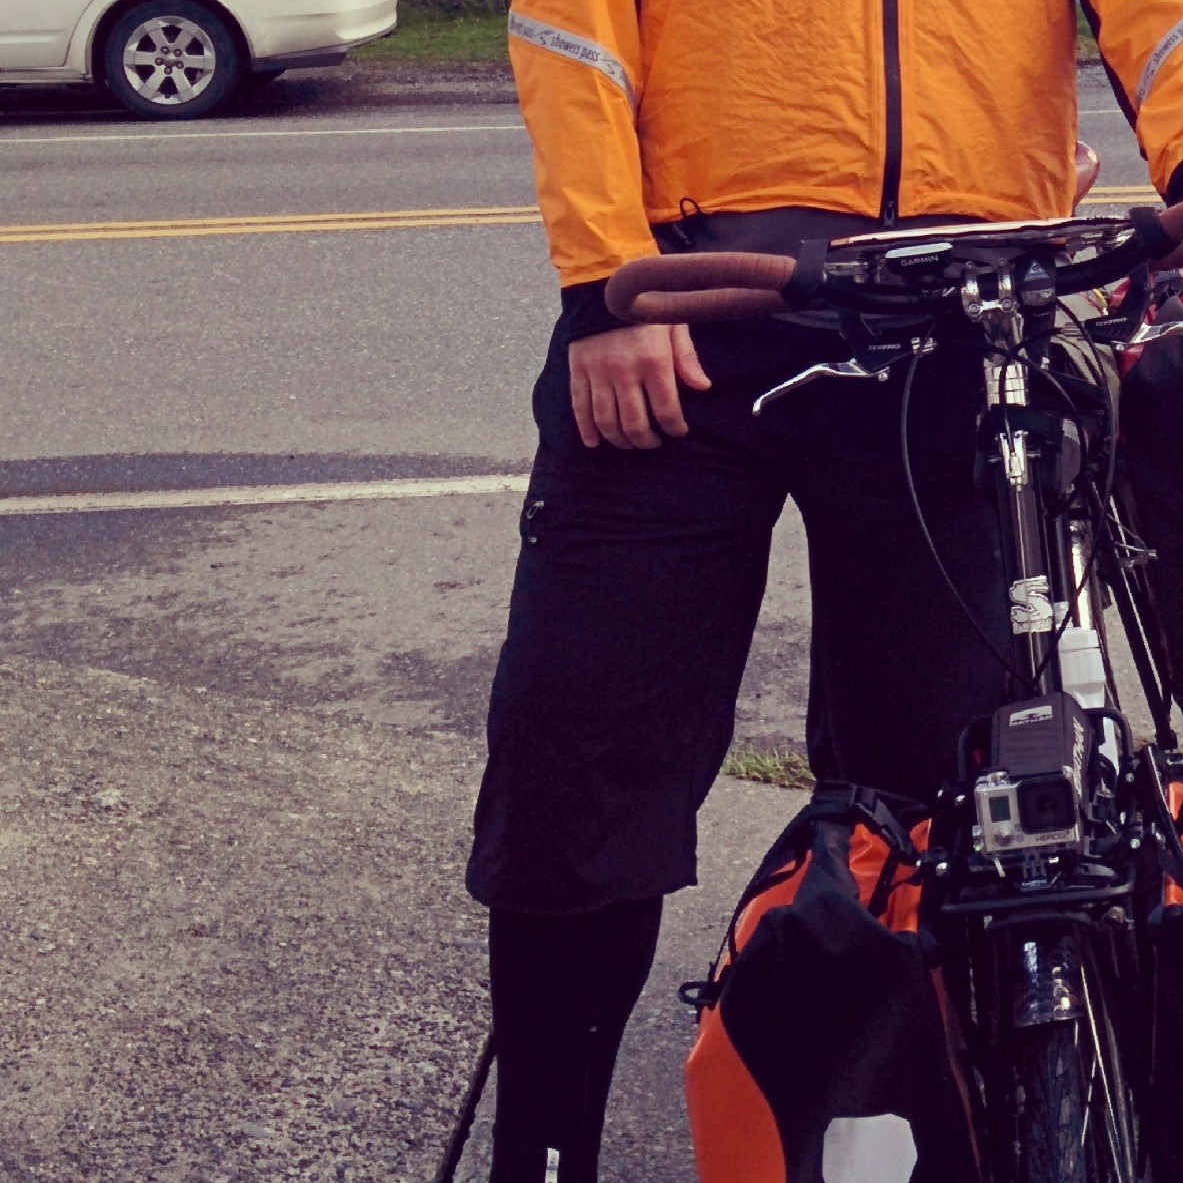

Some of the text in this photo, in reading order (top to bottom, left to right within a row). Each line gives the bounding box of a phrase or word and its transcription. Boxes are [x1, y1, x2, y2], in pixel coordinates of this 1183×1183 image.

[551, 34, 601, 61] showers pass
[1153, 35, 1179, 64] showers
[900, 255, 939, 267] GARMIN
